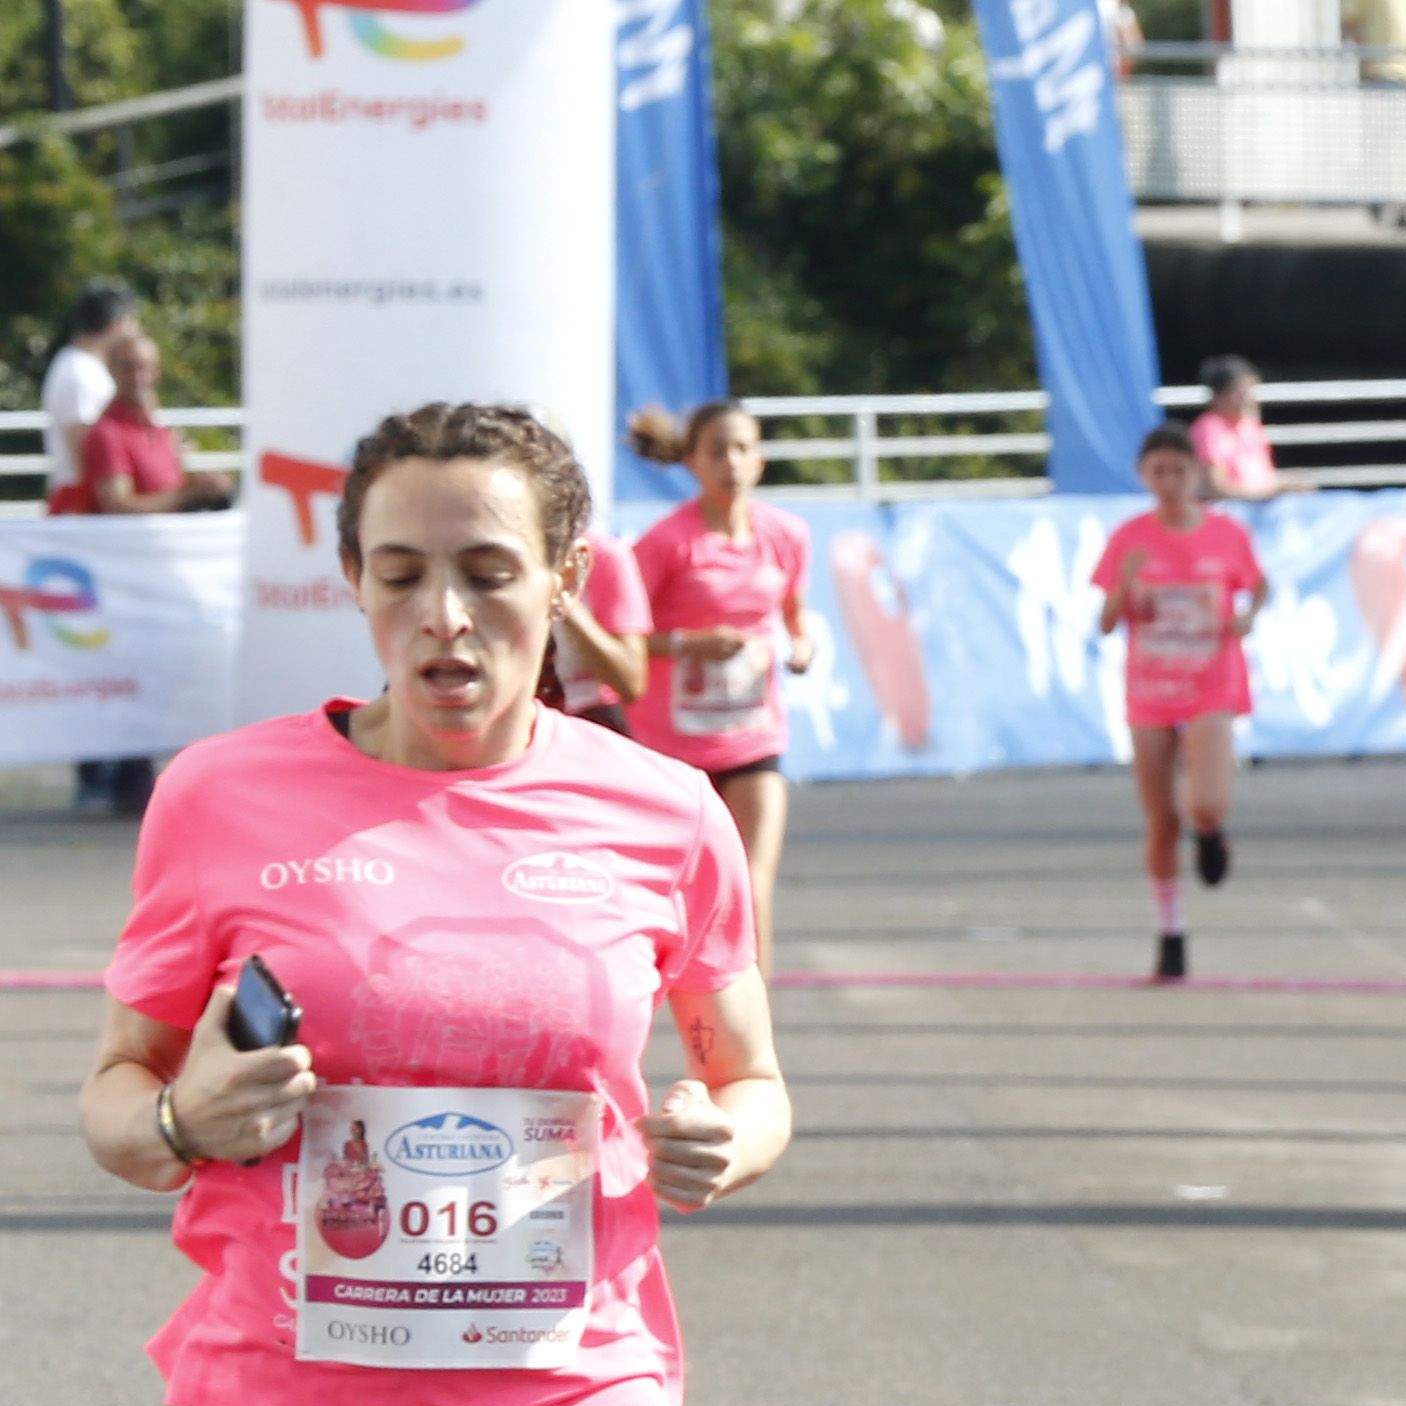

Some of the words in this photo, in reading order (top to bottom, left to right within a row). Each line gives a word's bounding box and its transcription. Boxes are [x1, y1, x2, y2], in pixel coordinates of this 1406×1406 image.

[260, 857, 395, 890] OYSHO
[394, 1136, 503, 1161] ASTURIANA
[399, 1201, 498, 1238] 016
[417, 1252, 479, 1276] 4684
[334, 1283, 410, 1303] CARRERA
[414, 1288, 441, 1304] DE
[441, 1288, 466, 1304] LA
[466, 1288, 526, 1303] MUJER
[532, 1288, 568, 1303] 2023
[327, 1319, 412, 1346] OYSHO
